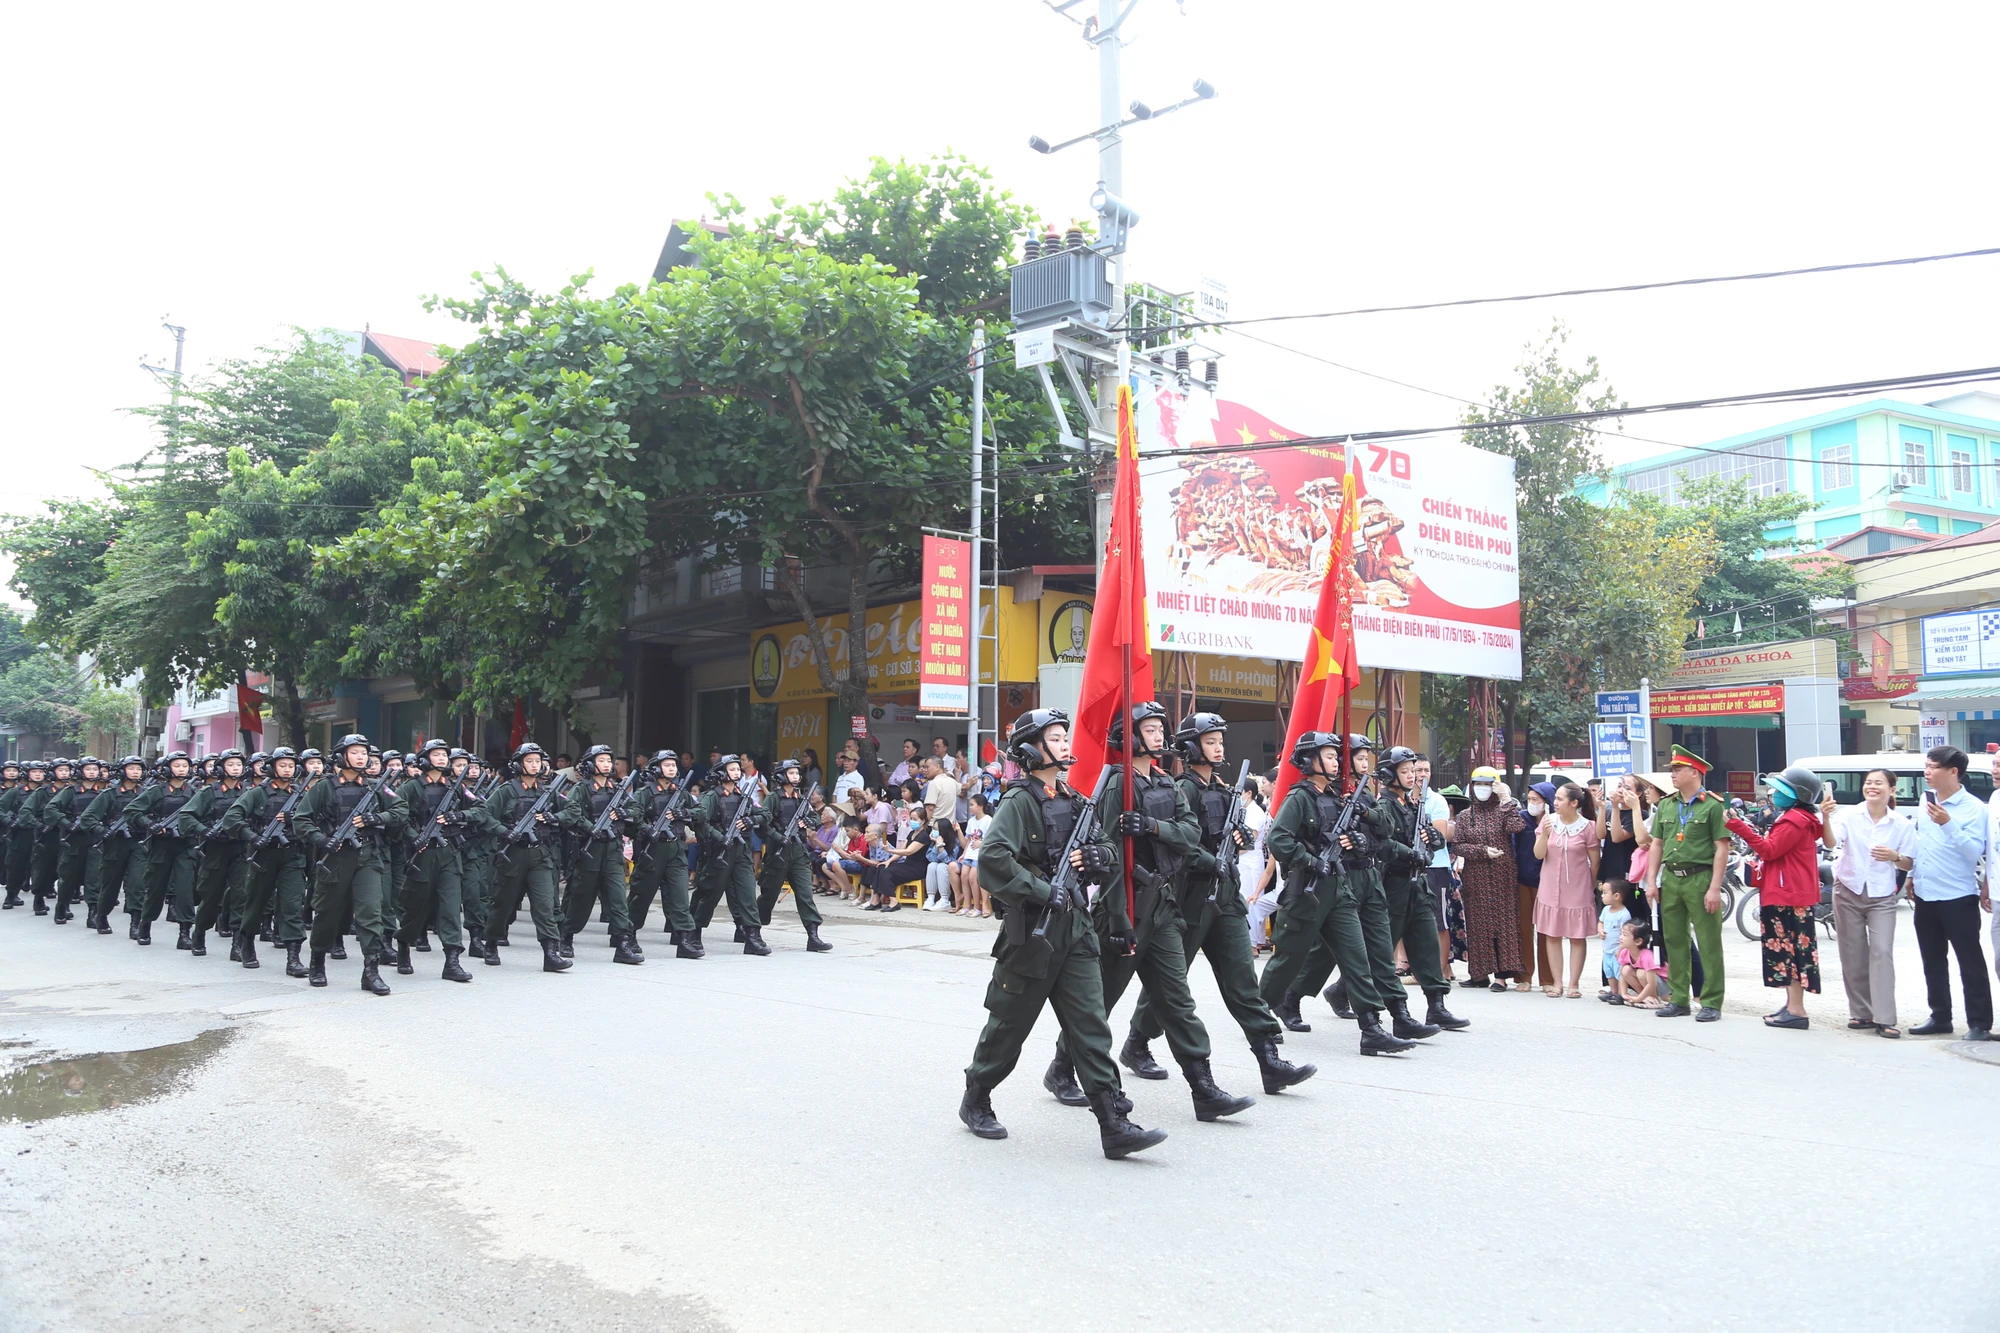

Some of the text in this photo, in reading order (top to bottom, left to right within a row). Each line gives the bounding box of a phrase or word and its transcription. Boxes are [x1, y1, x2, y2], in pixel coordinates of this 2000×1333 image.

[1200, 291, 1228, 313] TBA D41
[1367, 443, 1411, 481] 70
[1422, 497, 1508, 531] CHIẾN THẮNG
[1418, 522, 1512, 556] ĐIỆN BIÊN PHỦ
[938, 564, 957, 579] NƯỚC
[931, 583, 963, 599] CỘNG HOÀ
[936, 604, 958, 620] XÃ HỘI
[1156, 590, 1191, 614] NHIỆT
[1194, 593, 1217, 617] LIỆT
[1219, 596, 1248, 618] CHÀO
[1251, 600, 1282, 621] MỪNG
[1284, 606, 1296, 623] 70
[1353, 611, 1381, 632] THẮNG
[1383, 616, 1403, 638] ĐIỆN
[1404, 619, 1423, 638] BIÊN
[1424, 620, 1440, 640] PHỦ
[1442, 626, 1476, 645] (7/5/1954
[1482, 632, 1514, 650] 7/5/2024)
[929, 620, 964, 638] CHỦ NGHĨA
[1177, 631, 1254, 650] AGRIBANK
[1933, 633, 1969, 643] TRUNG TÂM
[931, 640, 961, 658] VIỆT NAM
[886, 662, 899, 676] CƠ
[900, 655, 912, 675] SỞ
[1720, 656, 1742, 665] ĐA
[1746, 650, 1793, 663] KHOA
[925, 661, 946, 676] MUÔN
[946, 662, 962, 677] NĂM
[1209, 665, 1277, 688] HẢI PHÒNG
[1671, 667, 1732, 677] POLYCLINIC
[927, 690, 963, 702] vinaphone
[1600, 701, 1638, 713] TÔN THẤT TÙNG
[1697, 700, 1710, 712] SOÁT
[1710, 699, 1726, 711] HUYẾT
[1726, 699, 1734, 710] ÁP
[1747, 698, 1763, 709] SỐNG
[780, 709, 822, 738] BÚN
[1605, 725, 1615, 735] BỆNH
[1922, 733, 1932, 748] TIẾT
